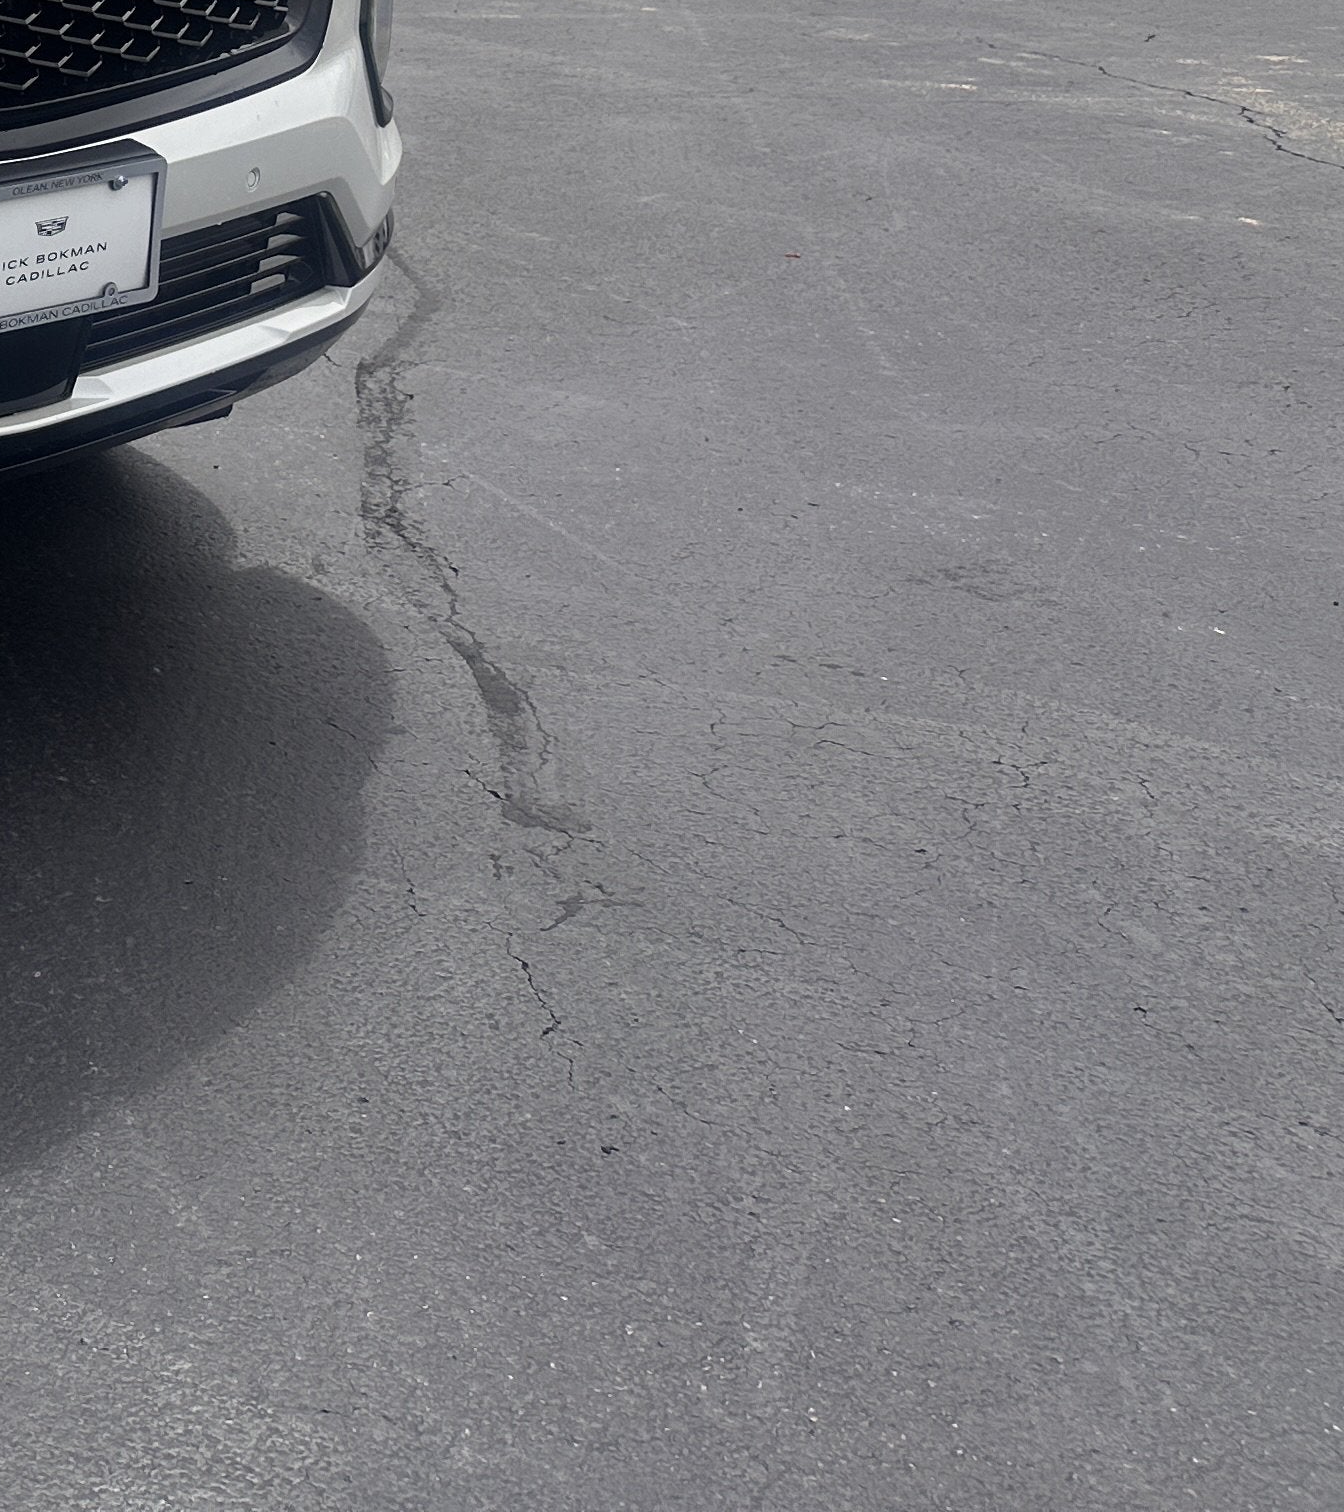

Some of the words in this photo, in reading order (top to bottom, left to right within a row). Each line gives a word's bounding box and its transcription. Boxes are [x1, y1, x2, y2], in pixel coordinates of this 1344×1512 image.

[51, 178, 75, 189] NEW
[75, 172, 104, 184] YORK
[36, 241, 108, 265] BOKMAN
[5, 261, 90, 286] CADILLAC
[0, 309, 59, 330] BOKMAN
[62, 295, 129, 317] CADILLAC
